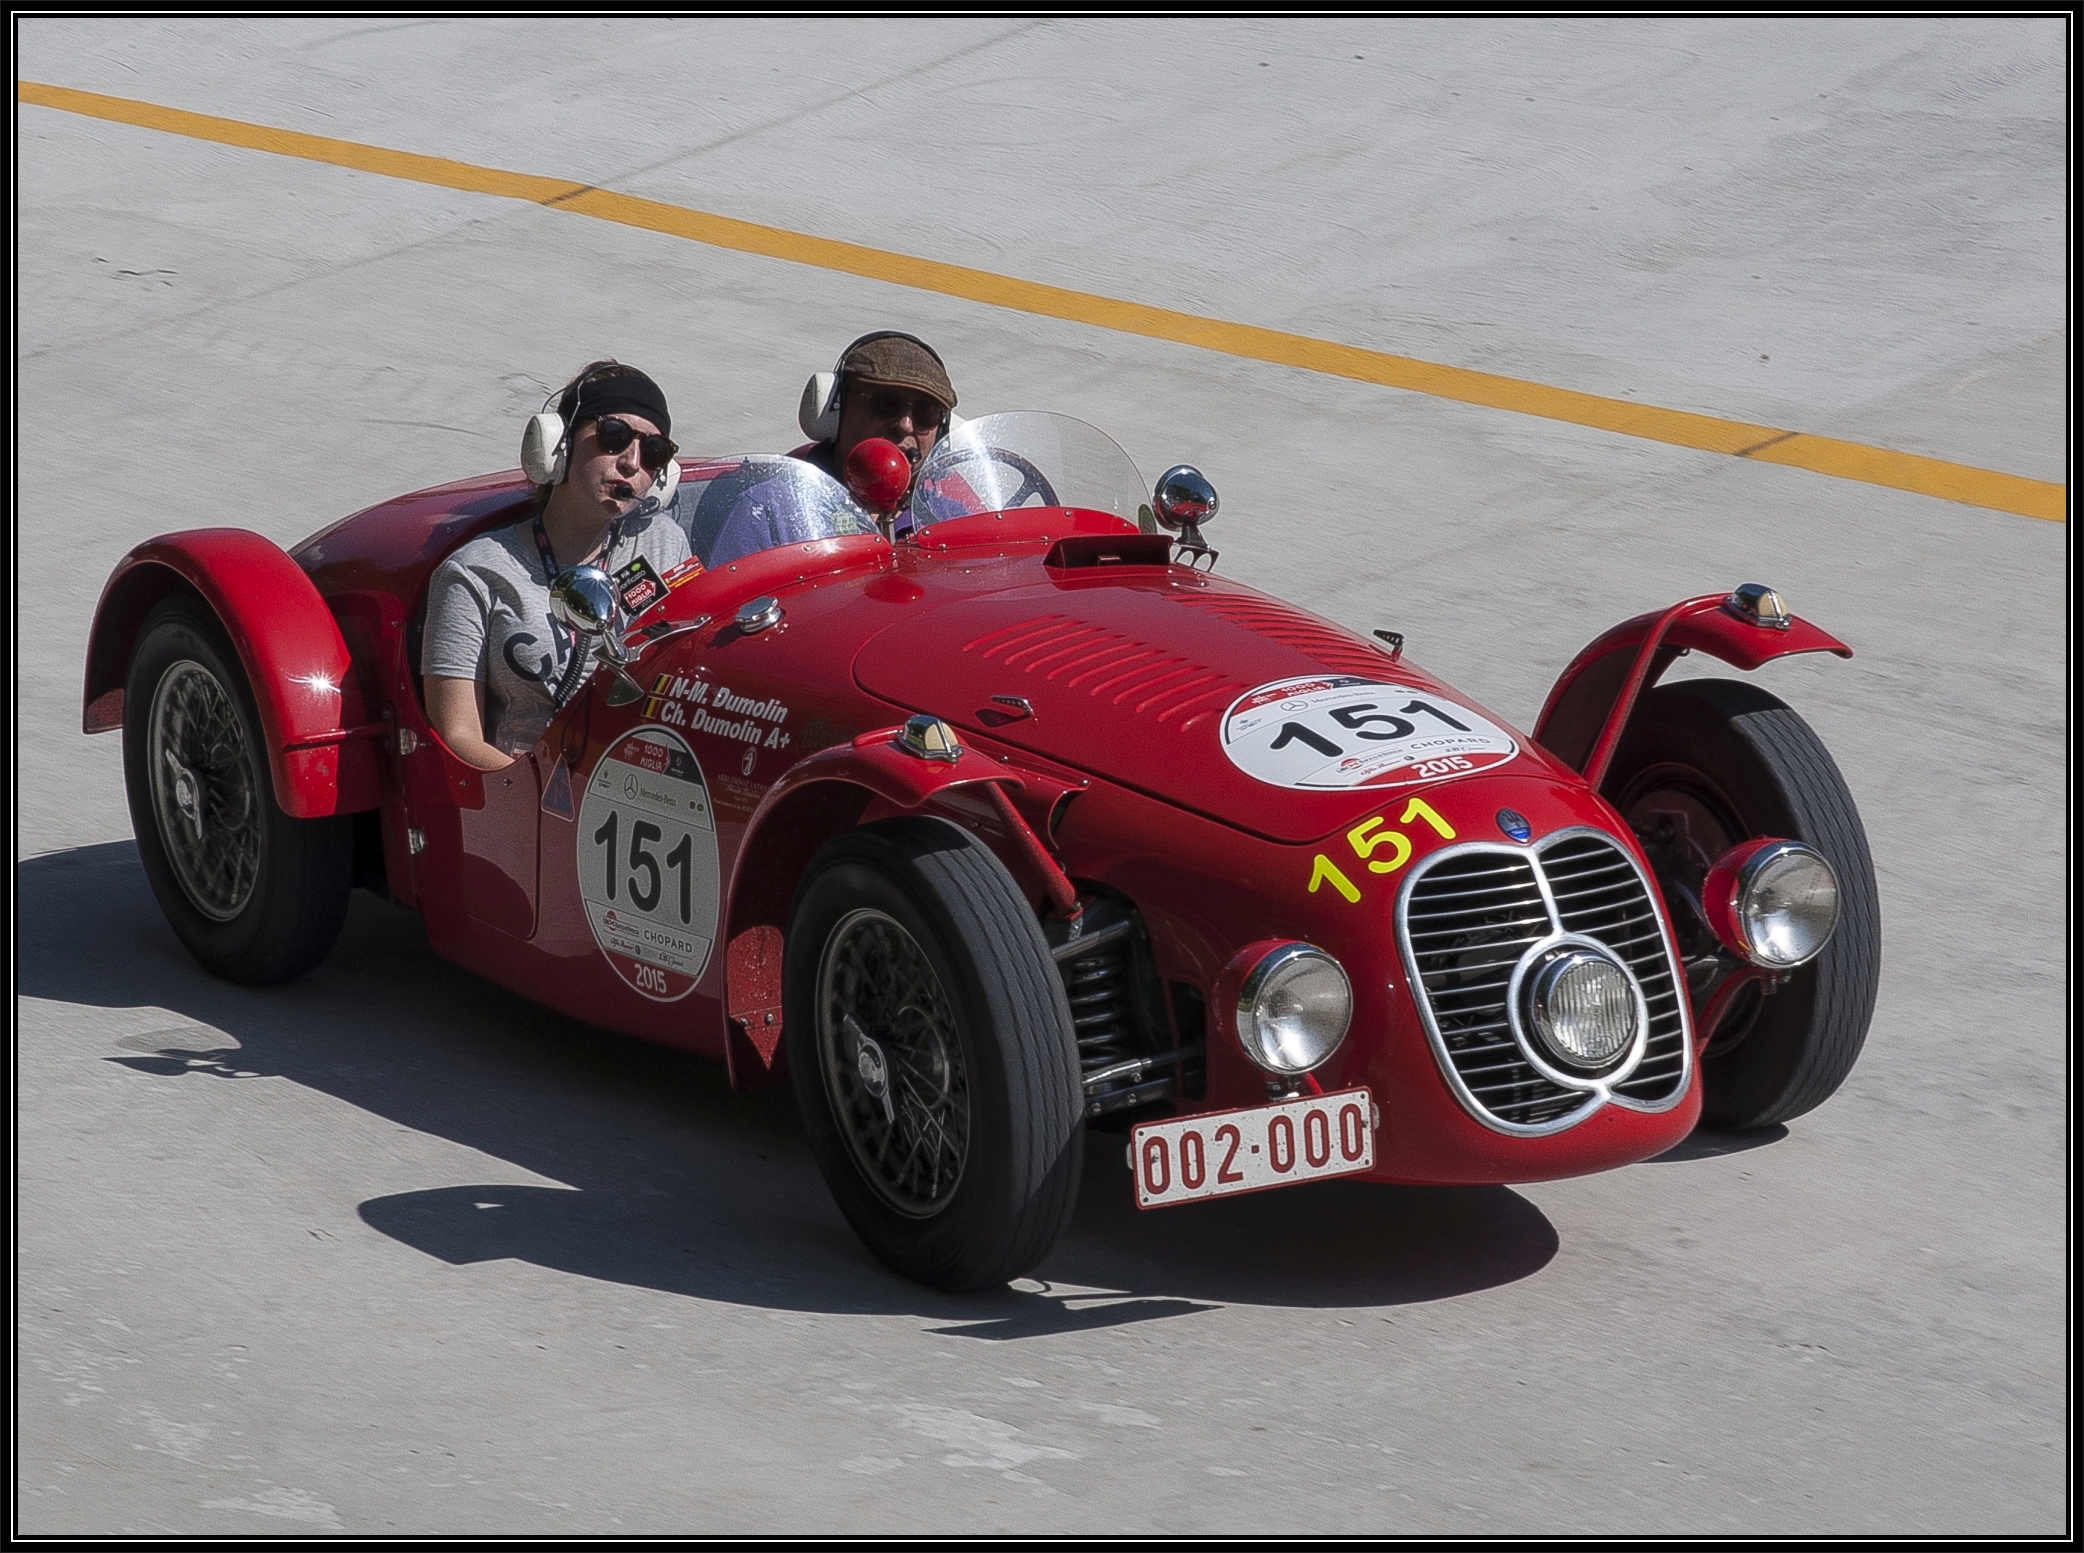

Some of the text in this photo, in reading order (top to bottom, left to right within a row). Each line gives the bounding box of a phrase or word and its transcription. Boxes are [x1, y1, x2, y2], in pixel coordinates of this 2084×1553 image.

[628, 584, 647, 599] 1000
[631, 588, 653, 606] MIGLIA
[1281, 682, 1317, 694] 1000
[1286, 685, 1327, 697] MIGLIA
[669, 676, 788, 724] N-M. Dumolin
[660, 701, 687, 726] Ch.
[691, 708, 763, 745] Dumolin
[763, 727, 791, 750] A+
[1269, 700, 1472, 757] 151
[644, 744, 664, 758] 1000
[1410, 738, 1491, 750] CHOPARD
[640, 756, 662, 771] MIGLIA
[1410, 756, 1474, 778] 2015
[1308, 797, 1457, 904] 151
[594, 810, 693, 925] 151
[643, 929, 693, 953] CHOPARD
[634, 963, 668, 994] 2015
